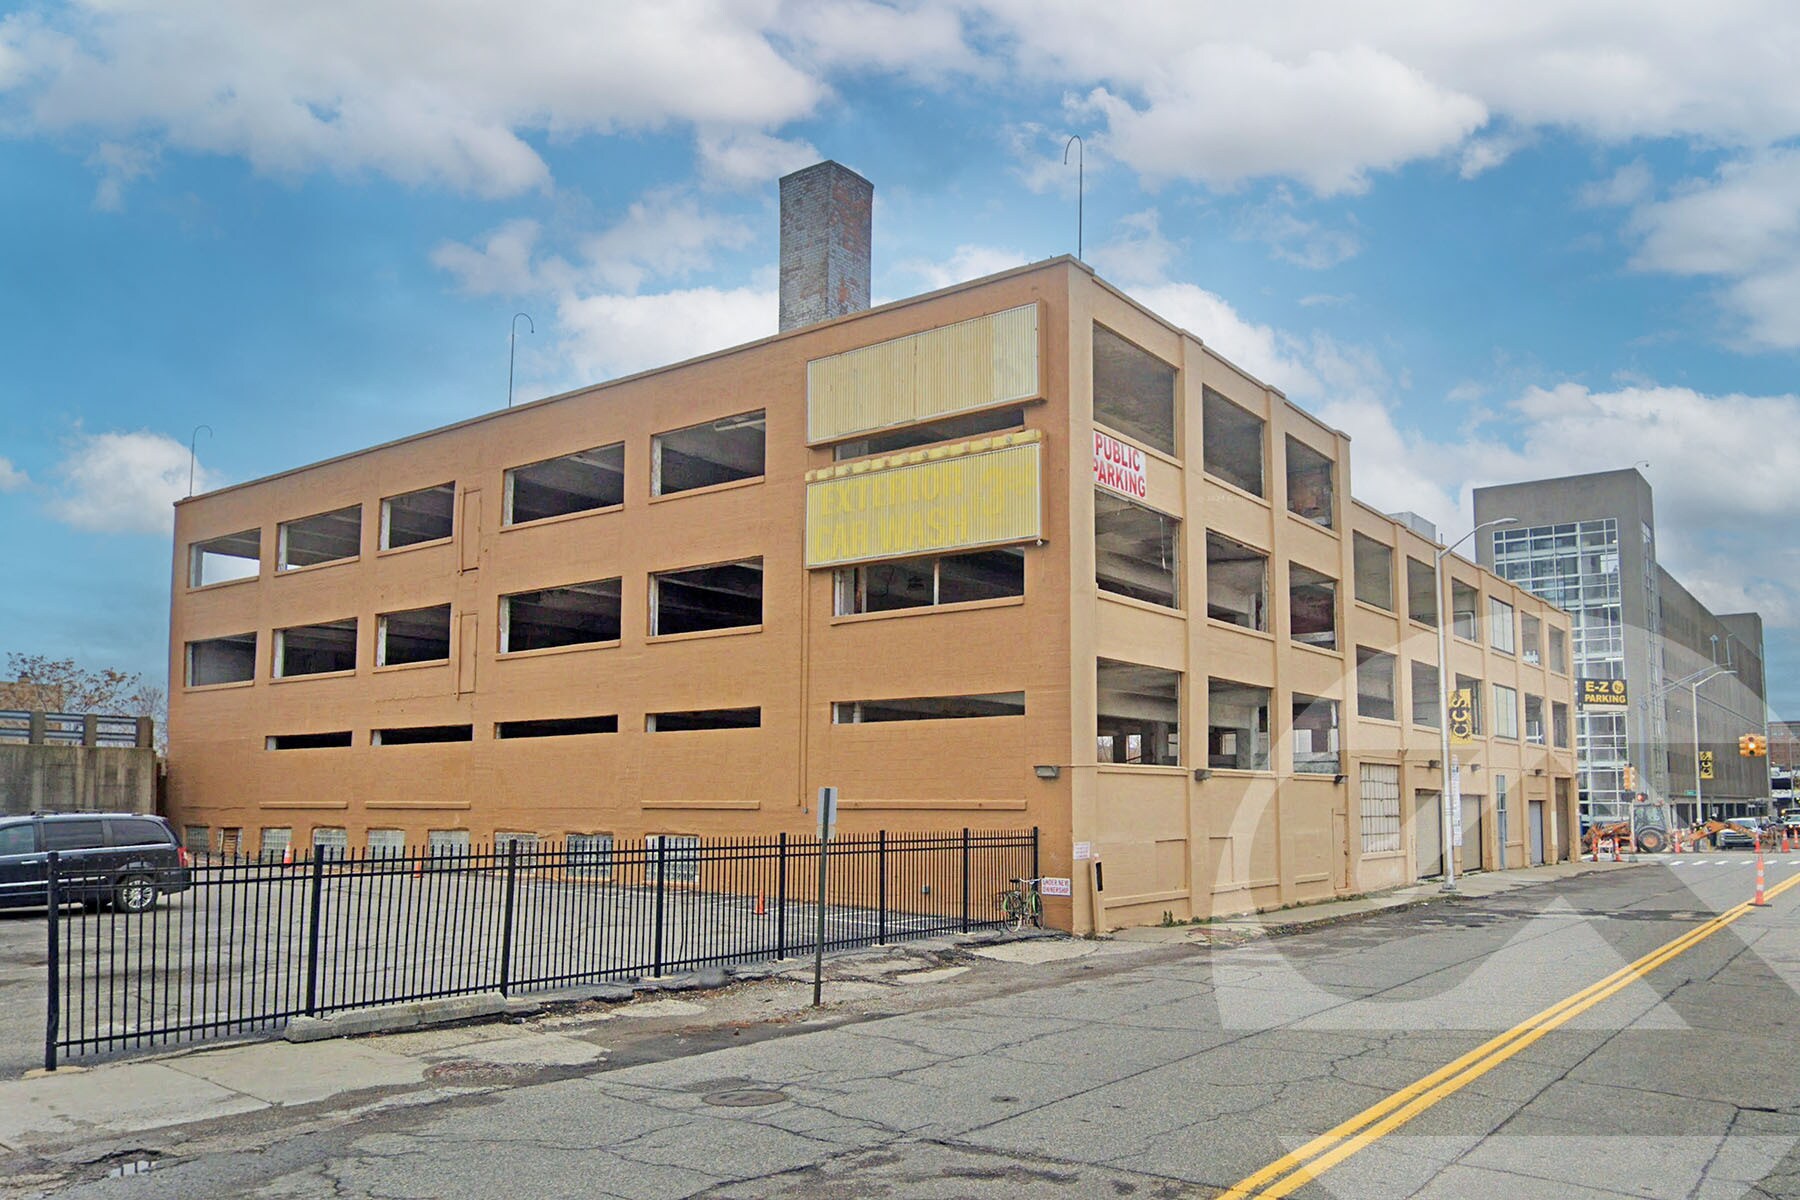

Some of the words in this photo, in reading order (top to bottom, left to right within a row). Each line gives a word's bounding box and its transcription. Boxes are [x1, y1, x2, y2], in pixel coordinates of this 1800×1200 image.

[1095, 433, 1141, 472] PUBLIC
[820, 464, 963, 517] EXTERIOR
[814, 520, 869, 561] CAR
[879, 503, 969, 550] WASH
[1584, 694, 1626, 703] PARKING
[1585, 681, 1609, 692] E-Z
[1452, 698, 1469, 737] CCS
